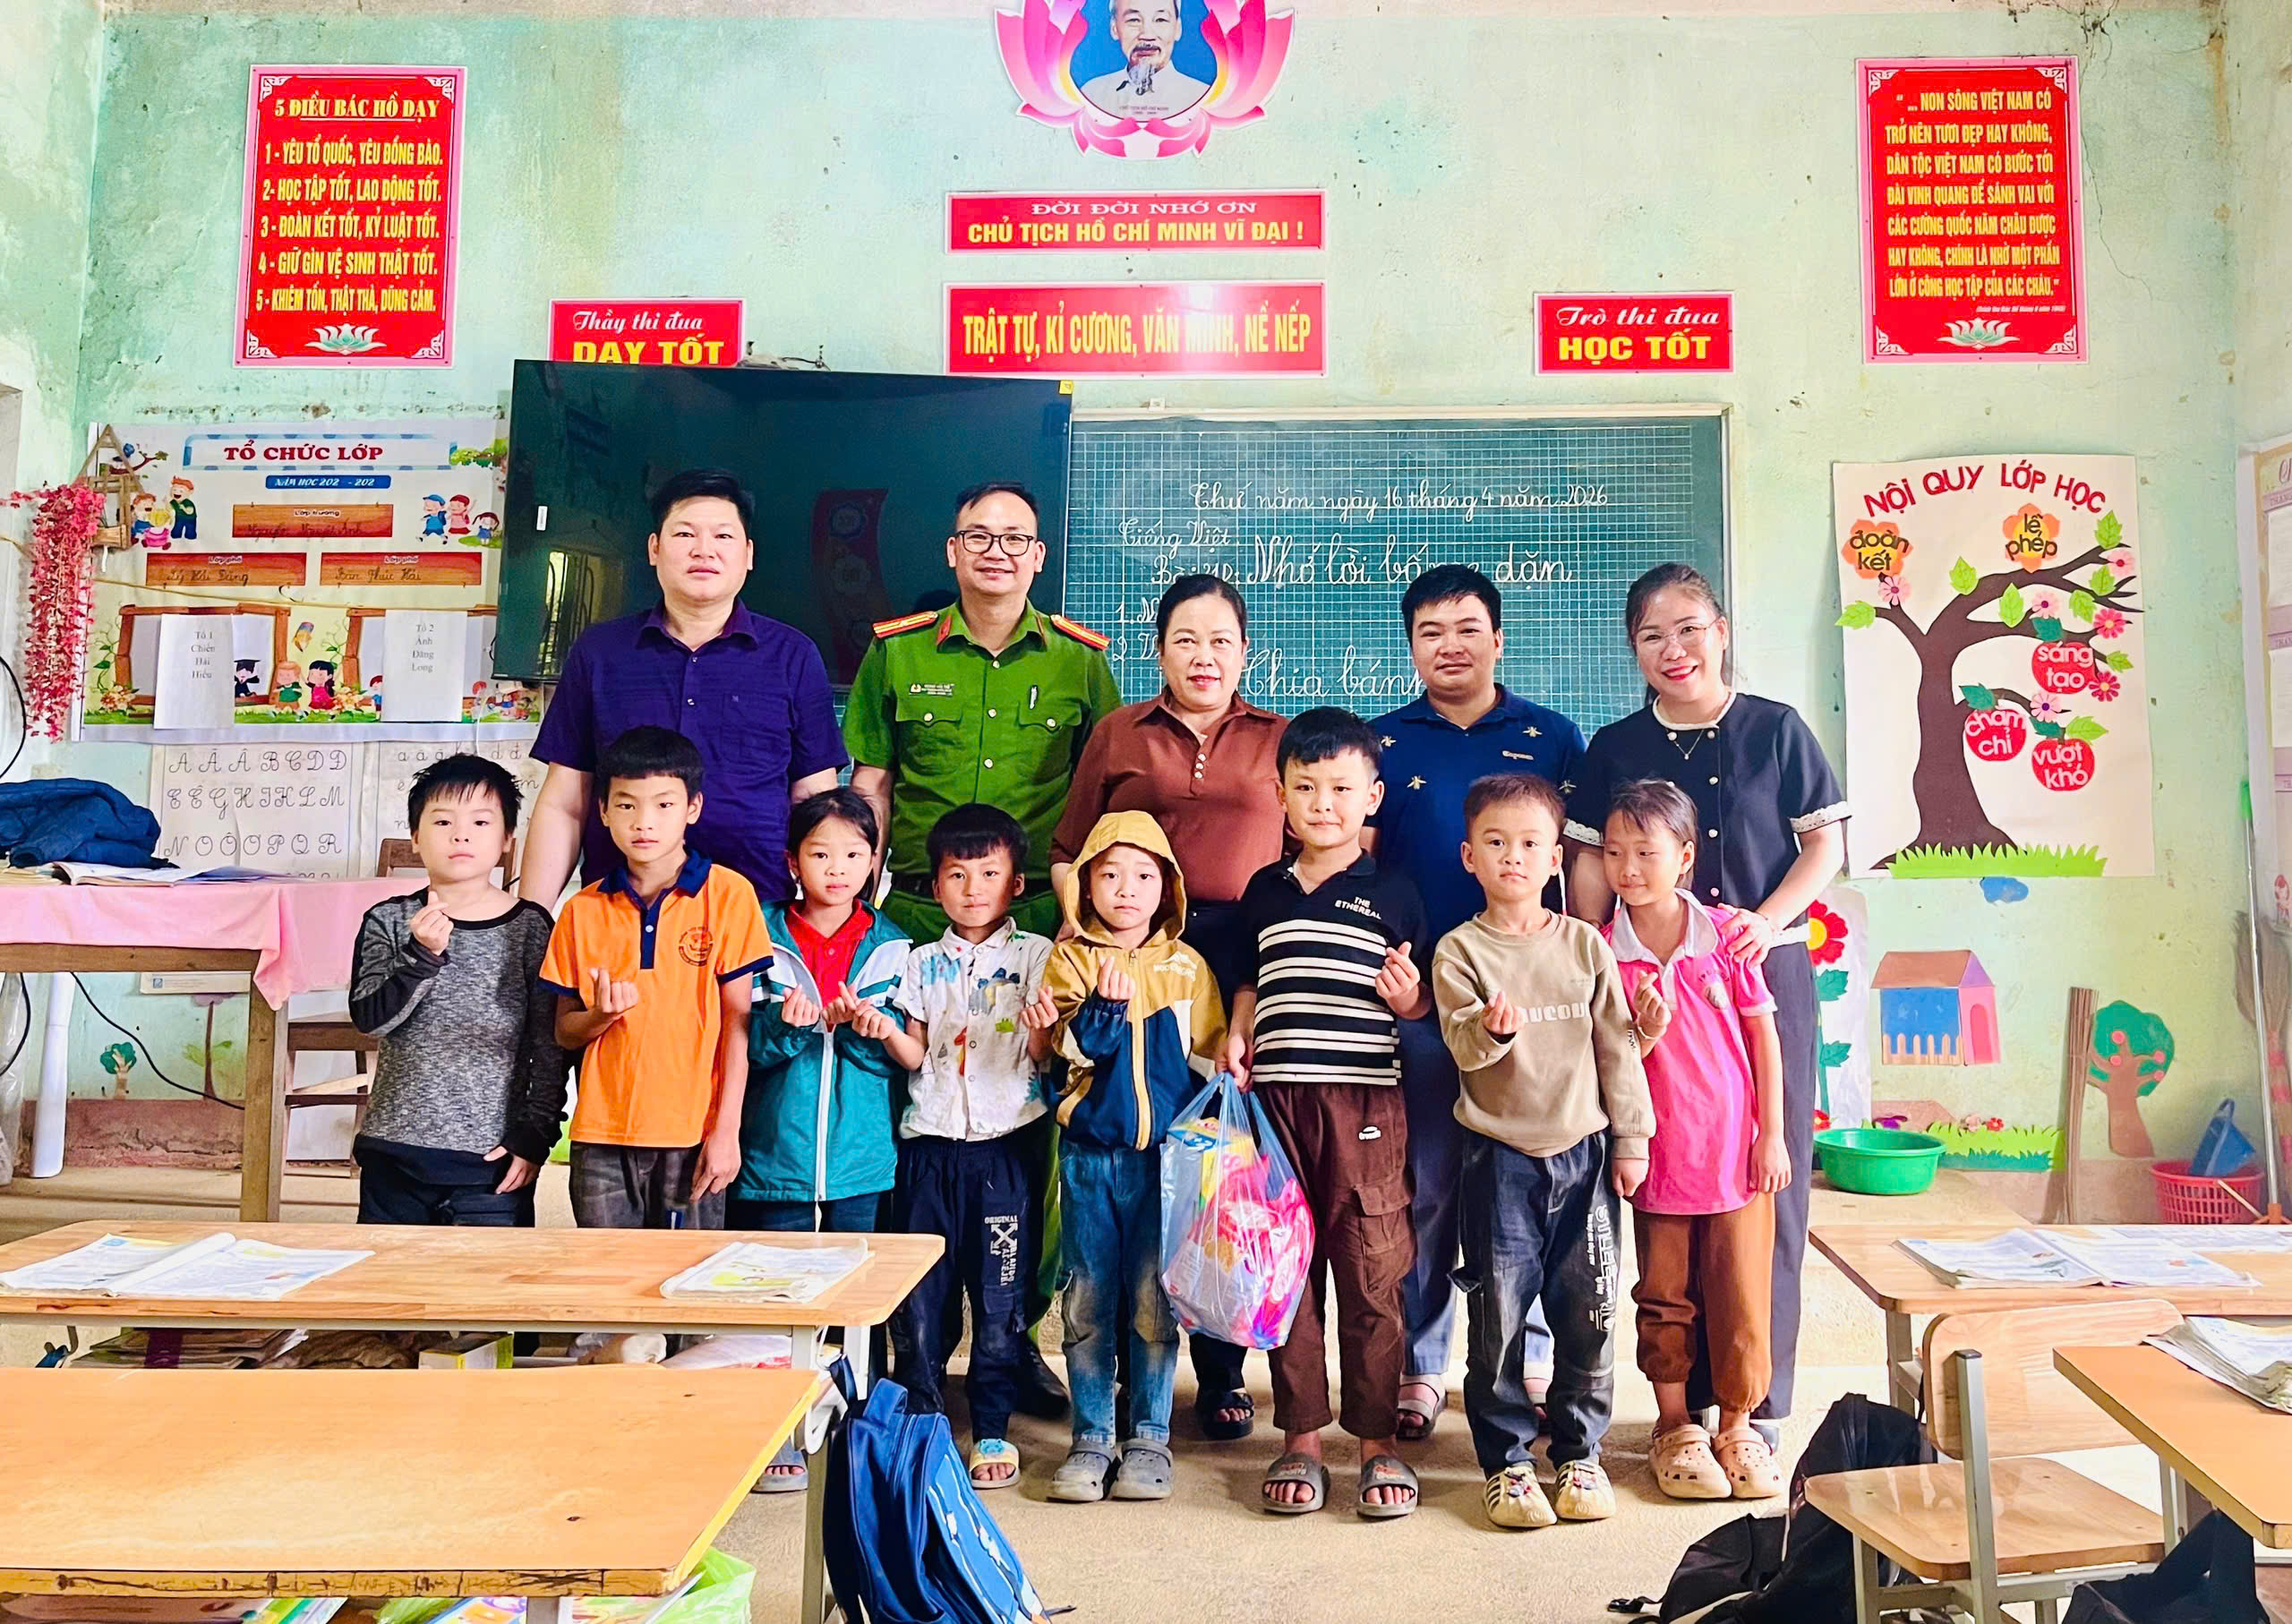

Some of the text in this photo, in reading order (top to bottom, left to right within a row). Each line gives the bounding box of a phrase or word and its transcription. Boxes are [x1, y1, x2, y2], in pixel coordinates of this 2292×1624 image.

[275, 90, 440, 122] 5 ĐIỀU BÁC HỒ DẠY
[1920, 87, 2051, 114] NON SÔNG VIỆT NAM CÓ
[1909, 122, 1932, 143] NÊN
[1962, 125, 1983, 147] ĐẸP
[1987, 124, 2007, 143] HAY
[266, 143, 270, 165] 1
[283, 138, 304, 165] YÊU
[360, 138, 381, 165] YÊU
[1911, 152, 1931, 178] TỘC
[1934, 151, 1956, 178] VIỆT
[1960, 155, 1985, 174] NAM
[1988, 150, 2002, 173] CÓ
[278, 179, 302, 206] HỌC
[304, 174, 327, 205] TẬP
[357, 179, 380, 201] LAO
[382, 175, 415, 206] ĐỘNG
[1907, 186, 1931, 205] VINH
[1934, 186, 1969, 207] QUANG
[2018, 185, 2035, 203] VAI
[1031, 200, 1257, 215] ĐỜI ĐỜI NHỚ ƠN
[261, 216, 269, 237] 3
[314, 208, 336, 237] KẾT
[384, 210, 413, 243] LUẬT
[968, 216, 1013, 243] CHỦ
[1021, 223, 1068, 246] TỊCH
[1076, 217, 1107, 242] HỒ
[1114, 218, 1150, 242] CHÍ
[1158, 222, 1217, 241] MINH
[1225, 218, 1245, 241] VĨ
[1253, 221, 1287, 244] ĐẠI
[259, 252, 267, 274] 4
[328, 247, 343, 278] VỆ
[346, 252, 376, 274] SINH
[380, 248, 409, 278] THẬT
[256, 289, 262, 311] 5
[573, 309, 703, 334] Thầy thi đua
[1556, 306, 1719, 326] Trò thi đua
[963, 308, 1007, 363] TRẬT
[1013, 311, 1040, 363] TỰ,
[1046, 301, 1065, 354] KỈ
[1070, 311, 1137, 358] CƯƠNG,
[1142, 305, 1180, 353] VĂN
[1245, 300, 1269, 352] NỀ
[1275, 298, 1311, 352] NẾP
[658, 333, 724, 365] TỐT
[1559, 329, 1711, 364] HỌC TỐT
[224, 440, 383, 460] TỔ CHỨC LỚP
[1923, 466, 1984, 496] QUY
[2000, 459, 2047, 493] LỚP
[2053, 474, 2106, 514] HỌC
[1189, 479, 1608, 523] Thứ năm ngày 16 tháng 4 năm 2026
[1119, 517, 1182, 560] Tiếng
[1849, 529, 1910, 553] đoàn
[2006, 531, 2057, 560] phép
[1247, 534, 1321, 583] Nhớ
[1325, 533, 1371, 584] lời
[1379, 534, 1429, 582] bố
[1495, 542, 1572, 589] dặn
[1858, 550, 1892, 571] kết
[413, 662, 432, 673] Long
[2037, 641, 2093, 668] sáng
[1241, 647, 1330, 697] Chia
[2046, 667, 2084, 692] tạo
[1978, 727, 2013, 756] chỉ
[2033, 742, 2083, 766] vượt
[169, 753, 192, 773] A
[228, 748, 251, 772] Â
[261, 751, 279, 771] B
[307, 750, 324, 770] D
[2044, 763, 2088, 788] khó
[1335, 900, 1381, 919] ETHEREAL
[1355, 897, 1370, 908] THE
[985, 1216, 1017, 1224] ORIGINAL
